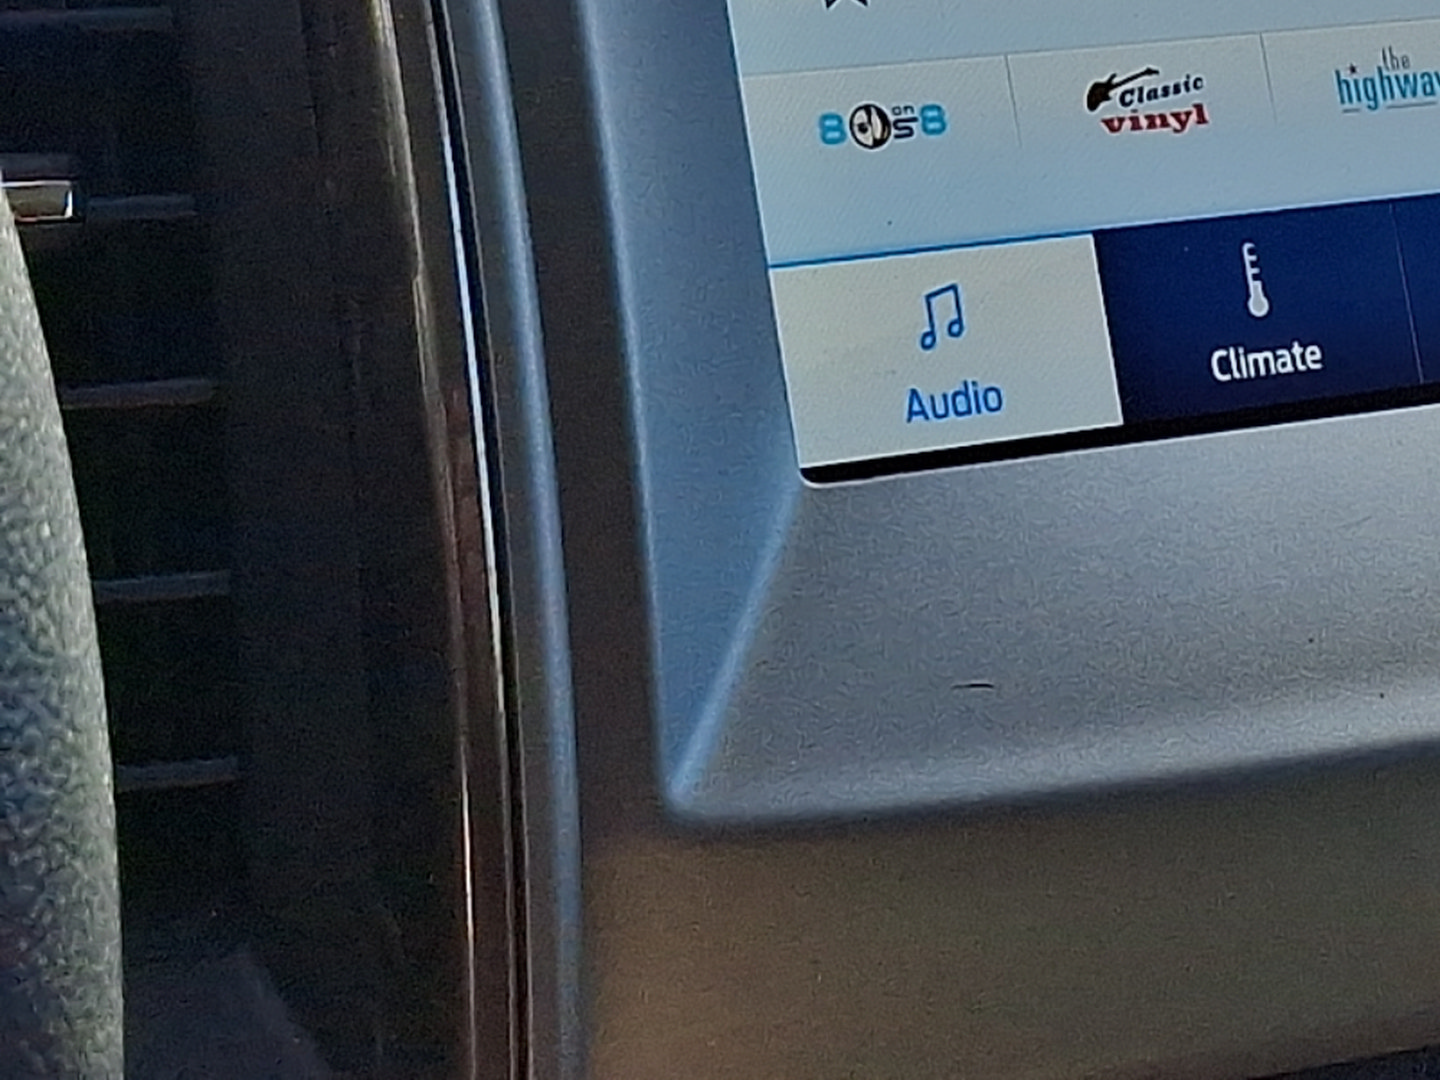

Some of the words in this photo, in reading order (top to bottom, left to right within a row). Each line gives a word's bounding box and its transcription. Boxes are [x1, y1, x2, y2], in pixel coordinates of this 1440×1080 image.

[1381, 45, 1410, 72] the
[1119, 74, 1204, 108] Classic
[1100, 103, 1209, 134] vinyl
[1210, 341, 1324, 382] Climate
[905, 379, 1004, 424] Audio
